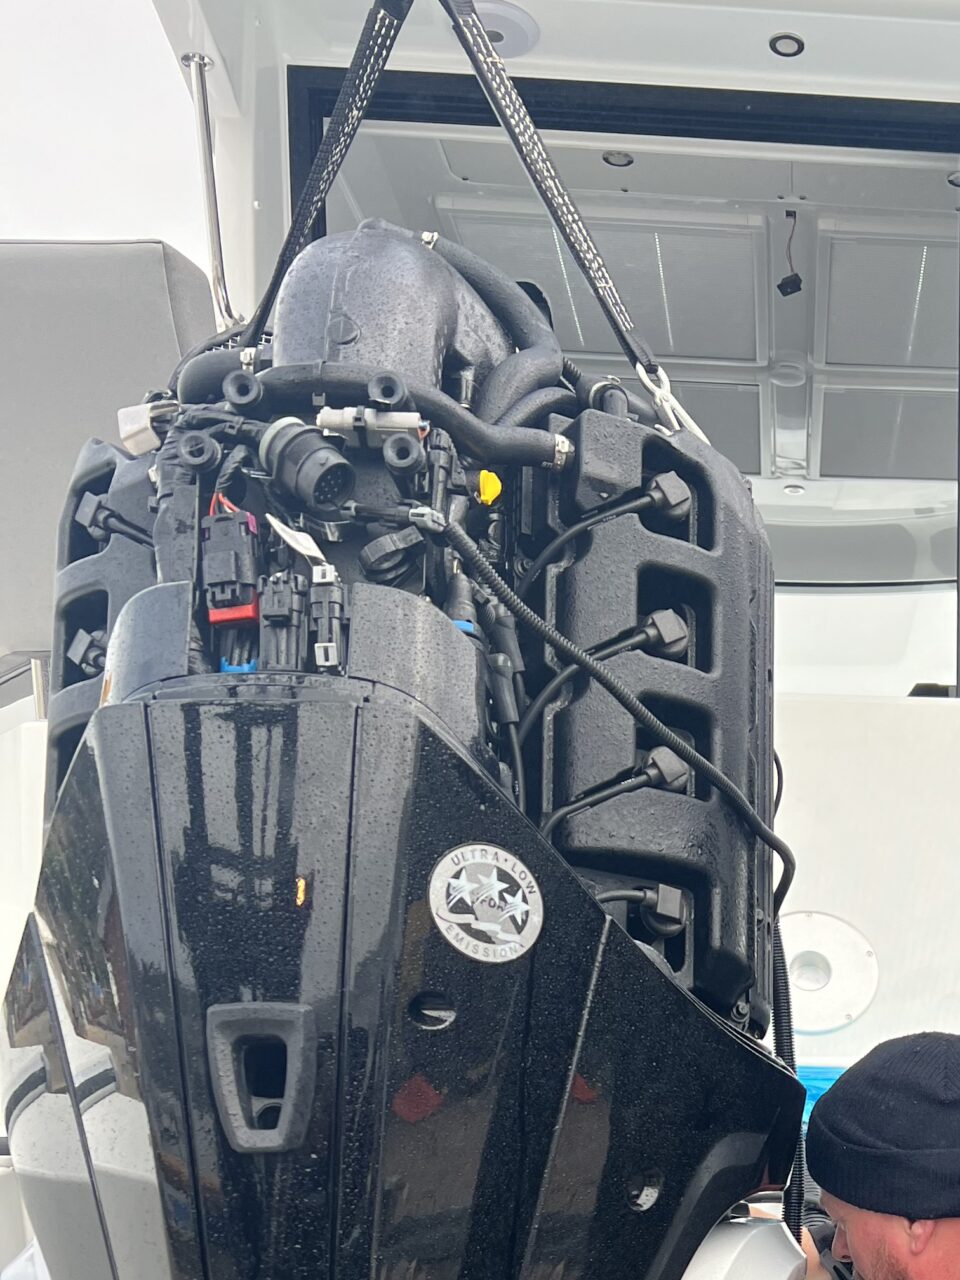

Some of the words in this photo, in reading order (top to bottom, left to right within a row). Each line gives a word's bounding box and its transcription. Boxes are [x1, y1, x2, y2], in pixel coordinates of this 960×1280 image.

[451, 849, 499, 866] ULTRA
[512, 863, 536, 895] LOW
[446, 924, 518, 957] EMISSION
